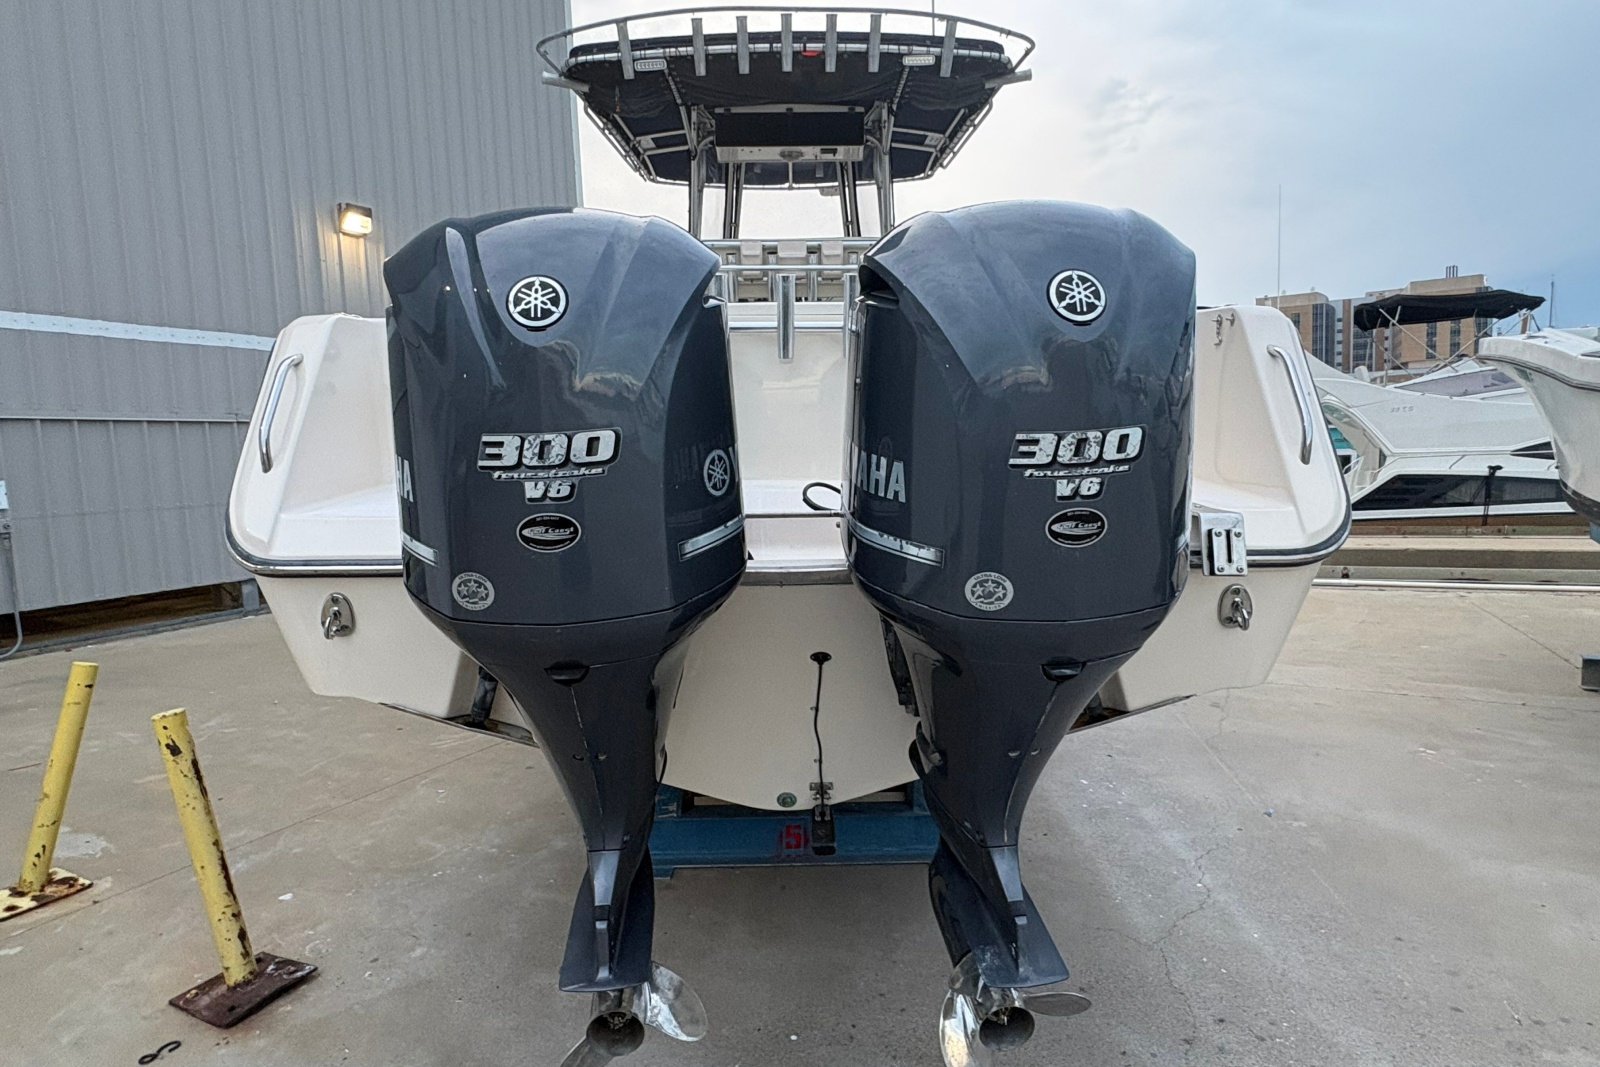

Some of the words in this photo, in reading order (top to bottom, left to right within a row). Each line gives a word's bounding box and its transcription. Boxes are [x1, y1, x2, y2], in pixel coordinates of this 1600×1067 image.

[478, 429, 618, 468] 300
[1008, 426, 1143, 466] 300
[524, 480, 574, 500] V6
[1056, 477, 1103, 498] V6
[785, 825, 802, 849] 5
